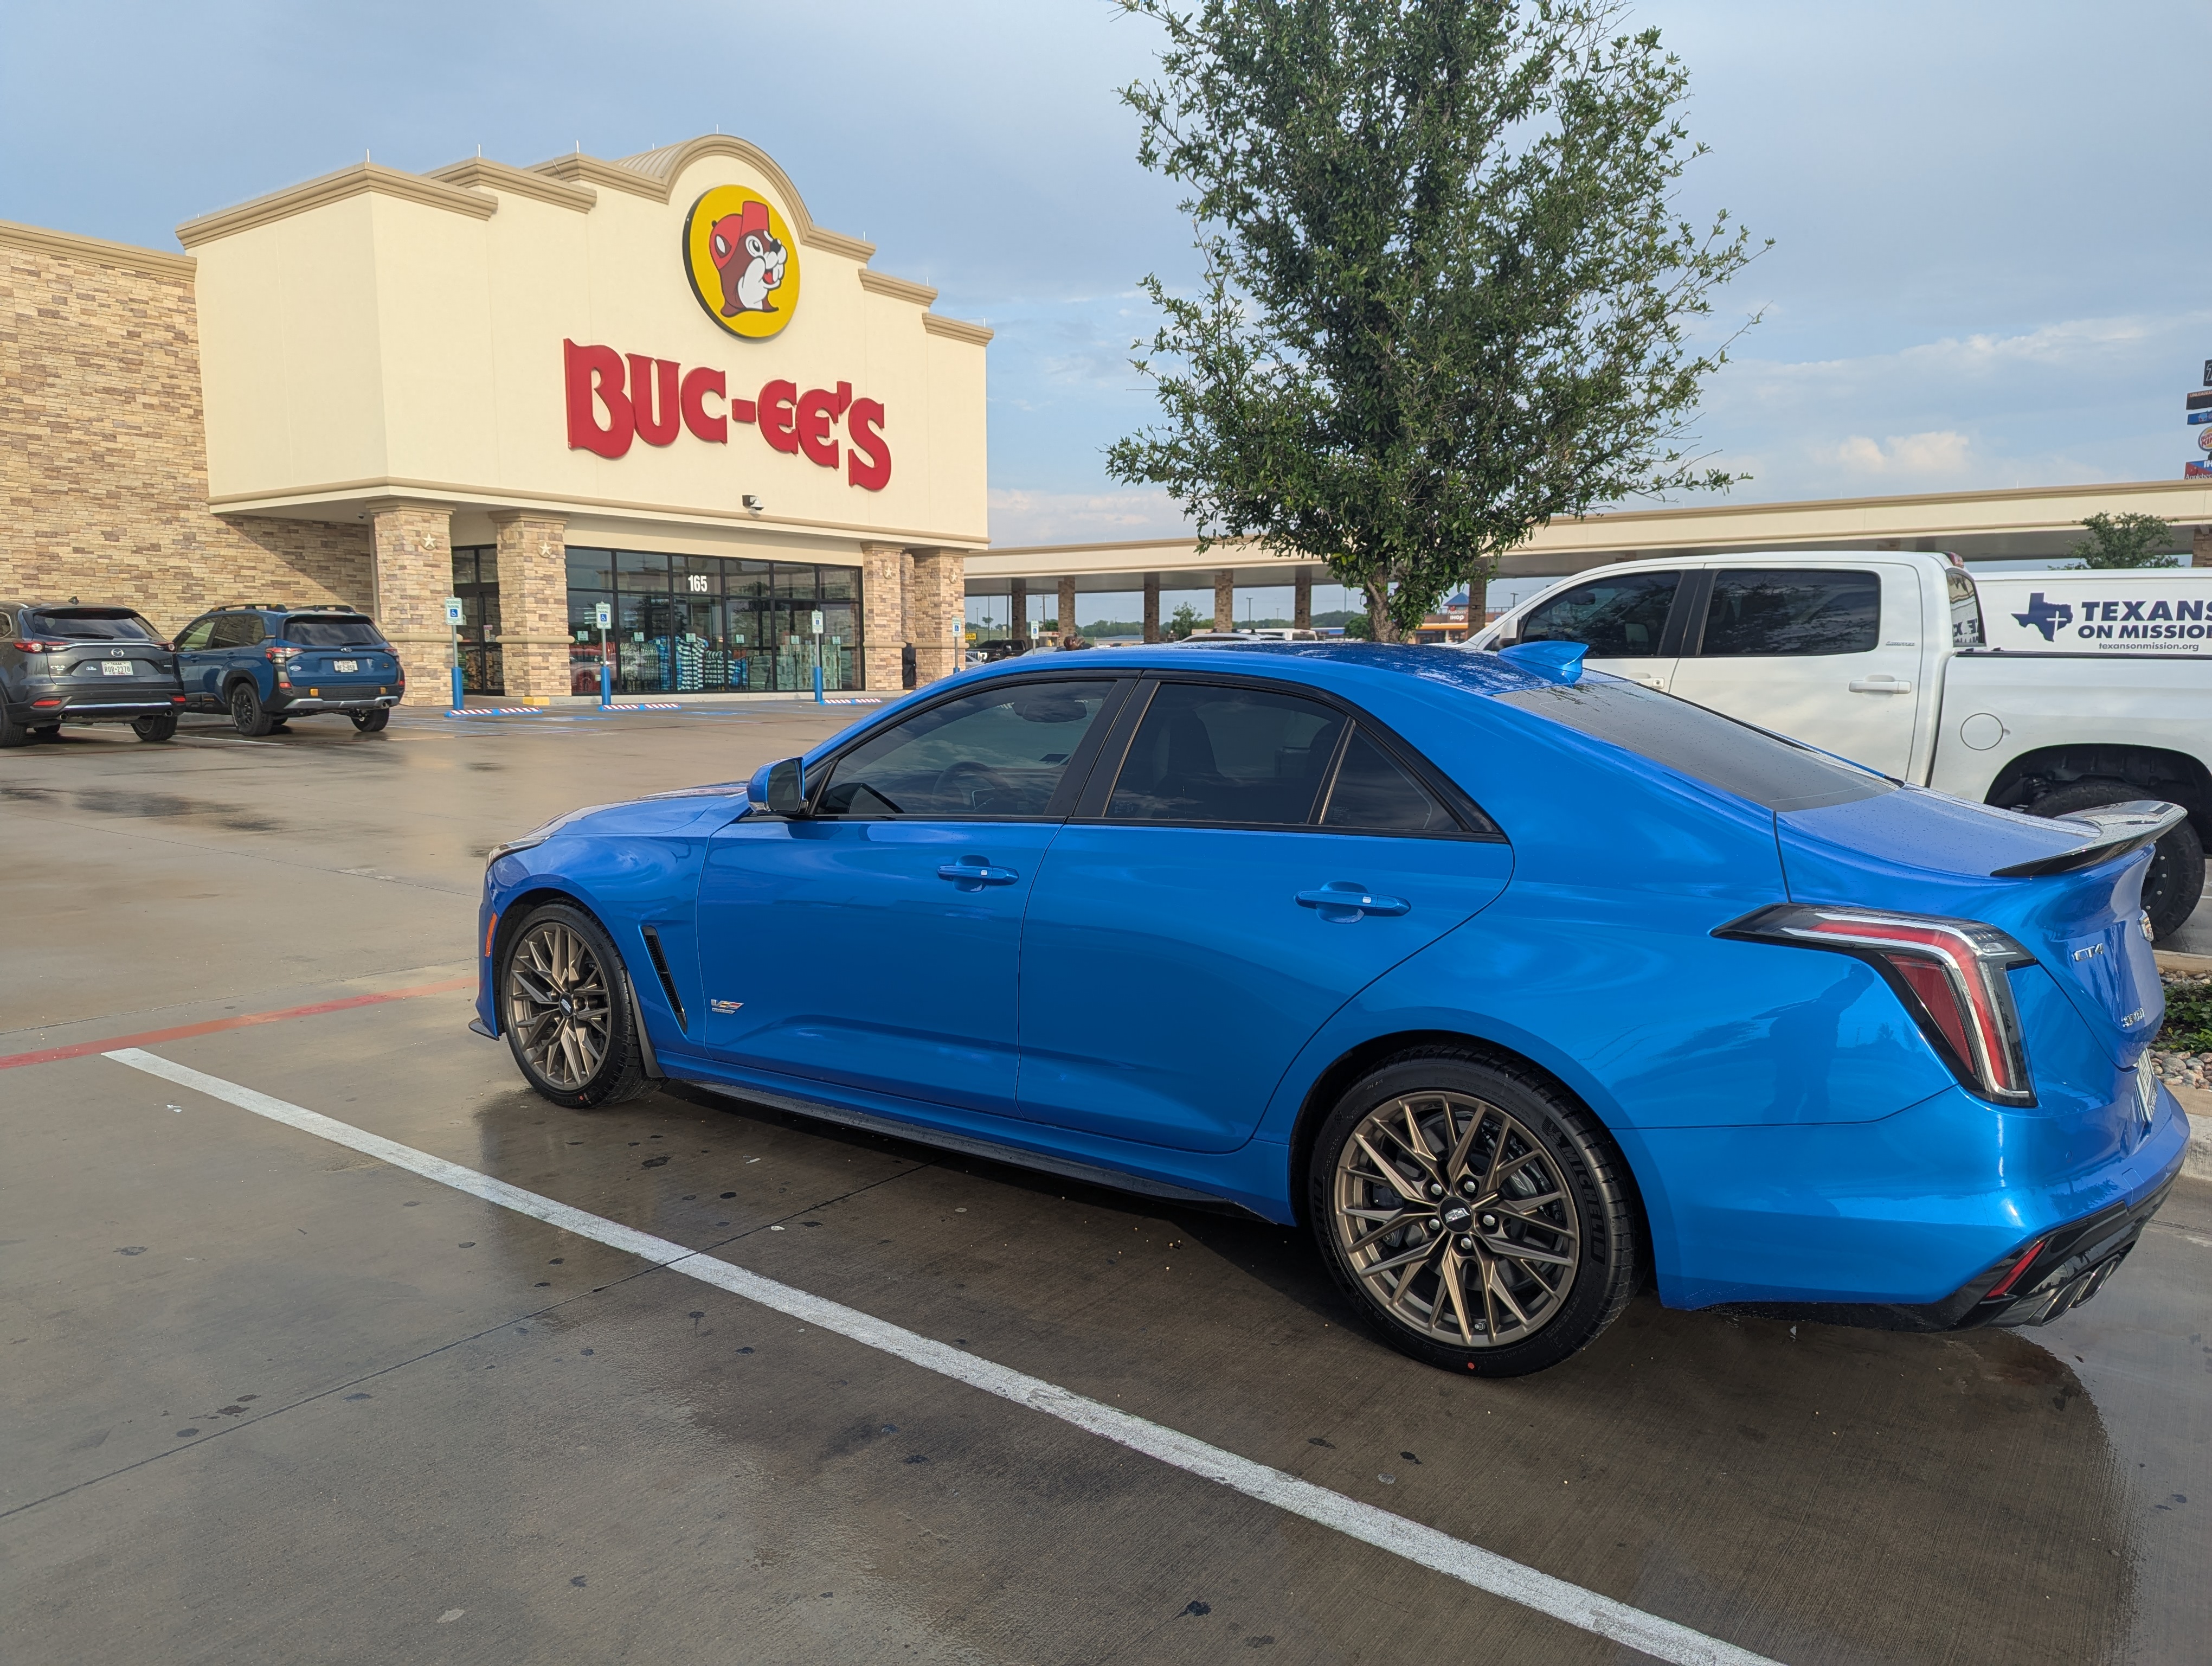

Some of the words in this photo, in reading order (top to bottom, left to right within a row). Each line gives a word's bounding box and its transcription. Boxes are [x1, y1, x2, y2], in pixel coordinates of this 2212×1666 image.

[563, 338, 892, 491] BUC-EE'S
[688, 575, 708, 592] 165
[2078, 625, 2113, 638] ON
[2099, 642, 2199, 651] texansonmission.org
[2074, 943, 2104, 961] CT4
[1561, 1145, 1605, 1259] MICHELIN
